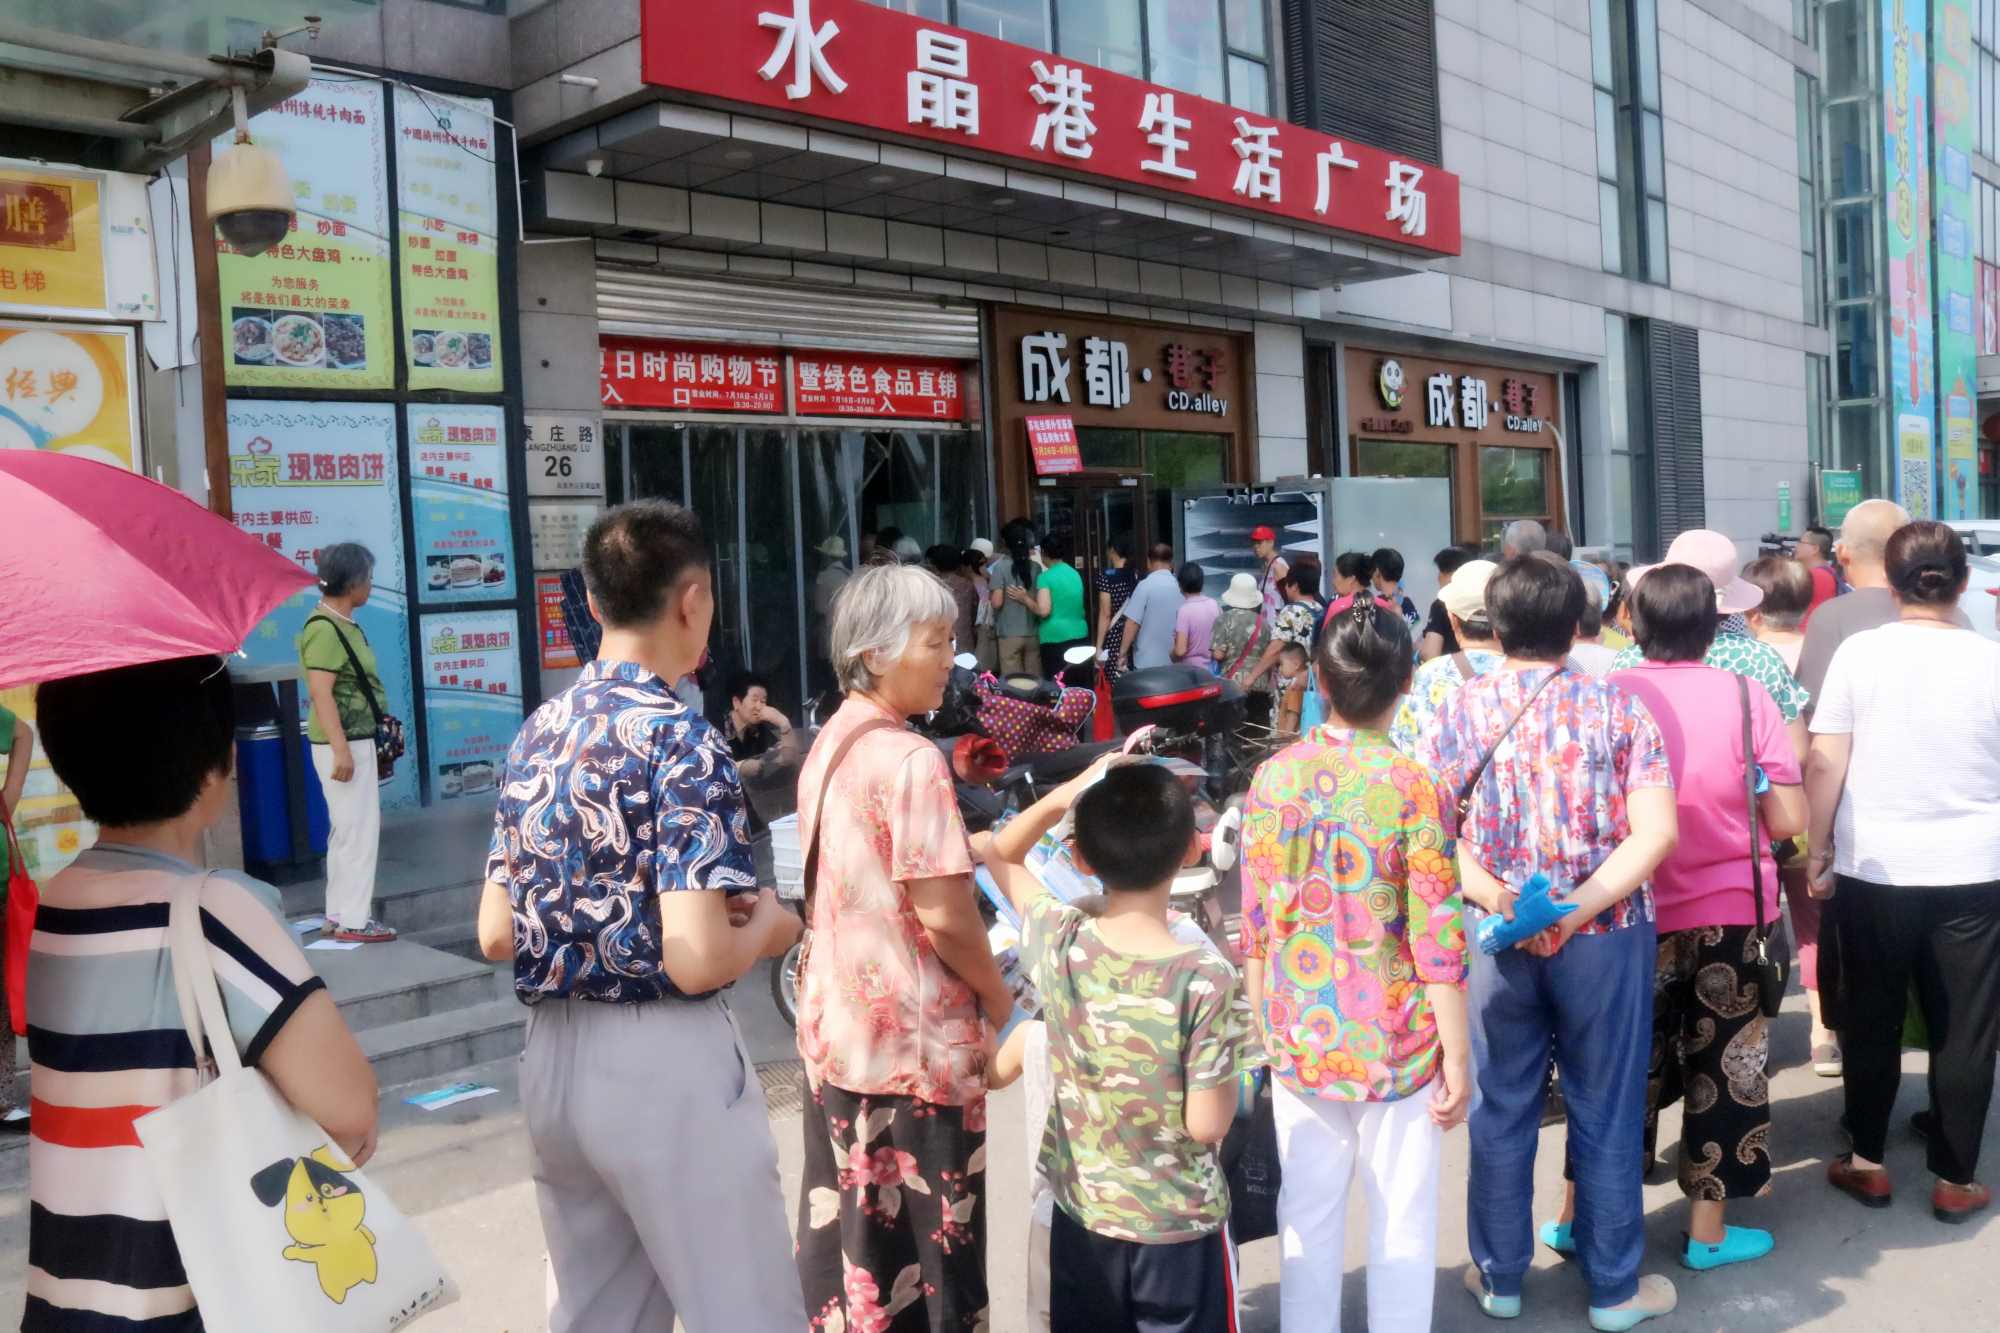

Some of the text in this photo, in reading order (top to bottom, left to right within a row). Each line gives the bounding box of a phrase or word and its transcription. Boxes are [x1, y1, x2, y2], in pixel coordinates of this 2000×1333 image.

[758, 0, 1428, 238] 水晶港生活广场
[5, 367, 79, 404] 经典
[800, 362, 957, 398] 暨绿色食品直销
[1168, 391, 1228, 417] CD.alley
[288, 453, 384, 481] 现烙肉饼
[545, 455, 572, 477] 26
